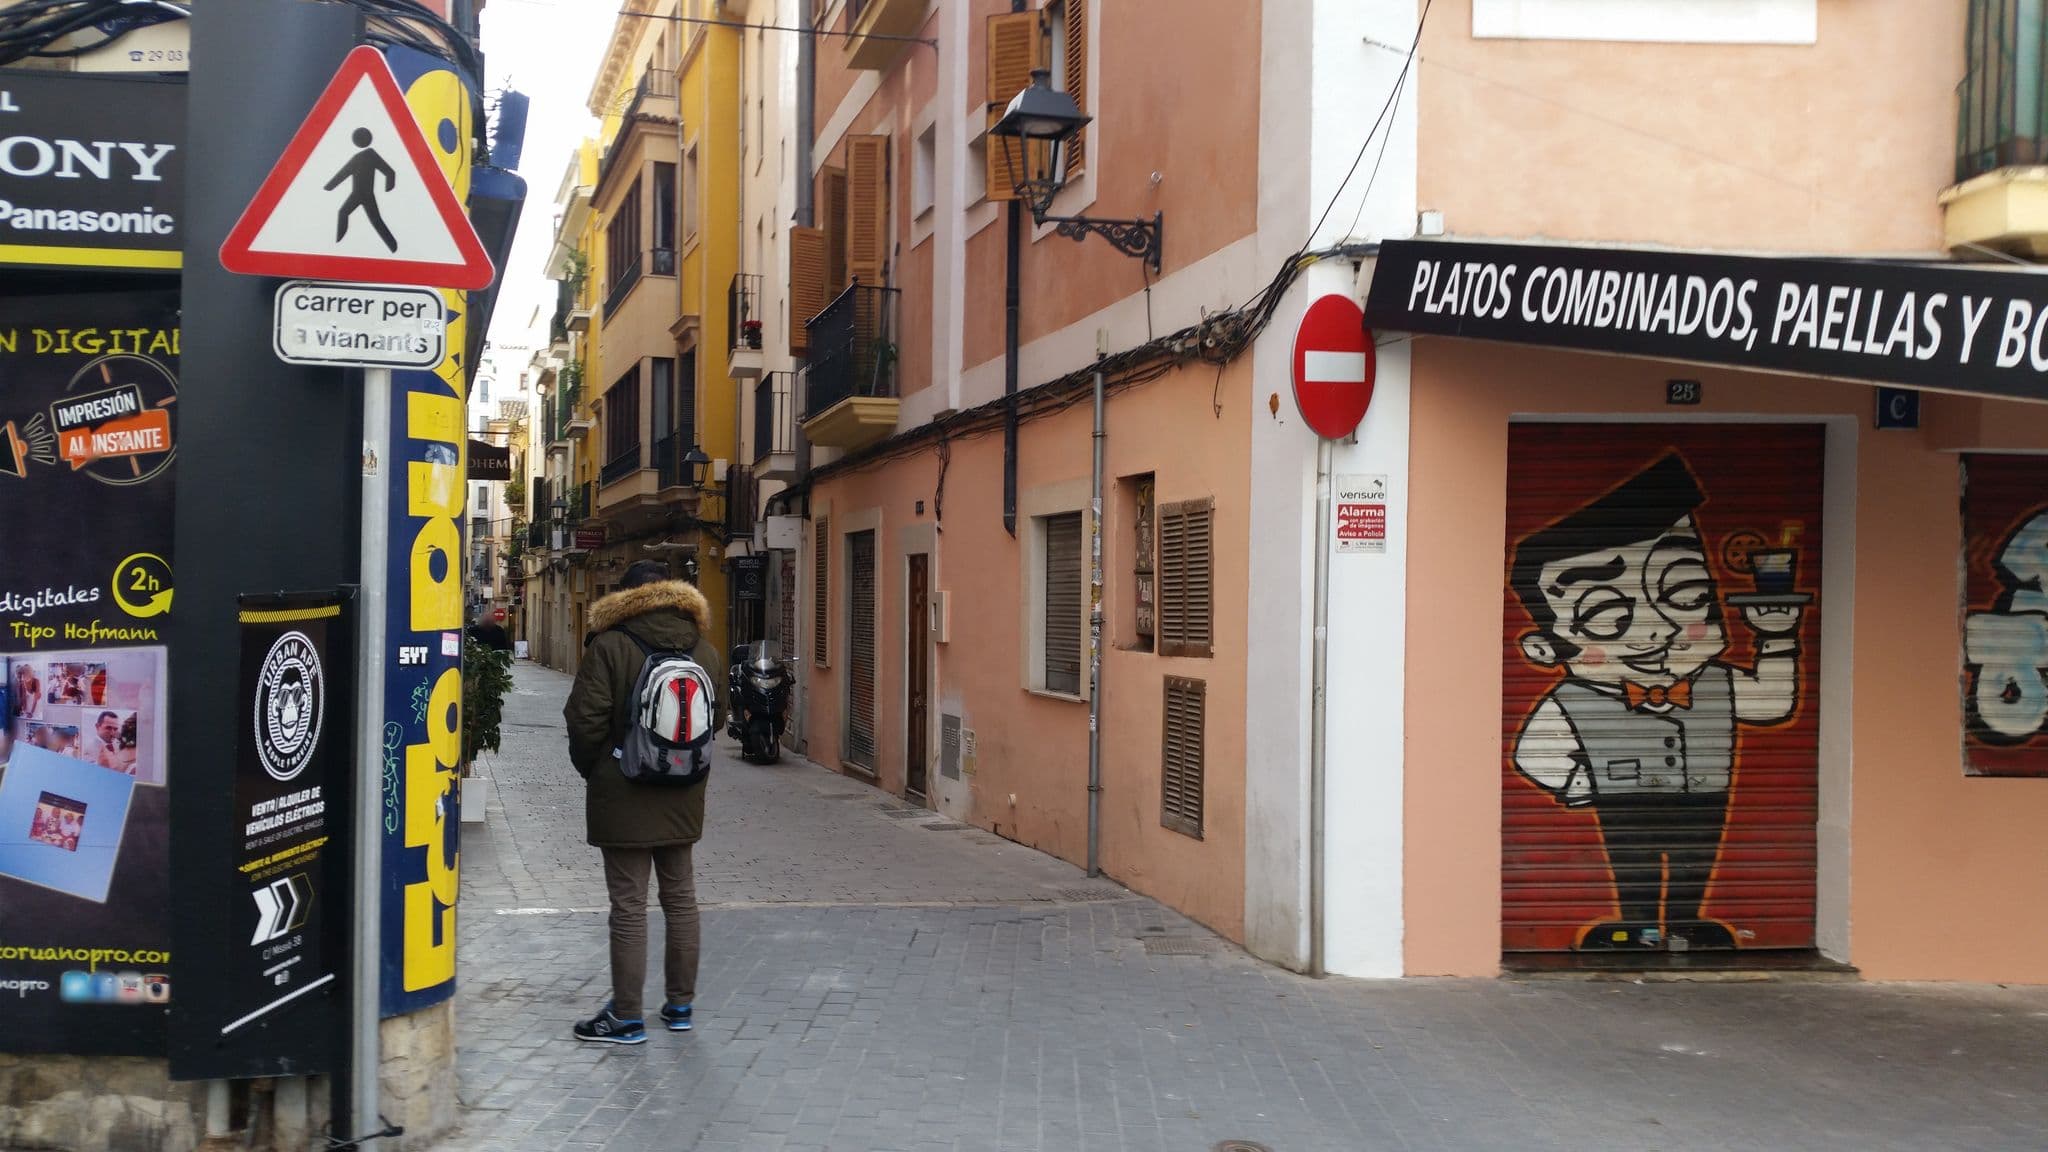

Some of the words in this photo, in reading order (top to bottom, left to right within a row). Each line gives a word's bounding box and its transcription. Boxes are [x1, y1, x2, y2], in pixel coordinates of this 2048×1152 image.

[148, 50, 163, 62] 29
[294, 294, 374, 315] carrer
[382, 300, 427, 321] per
[1407, 259, 1518, 320] PLATOS
[1521, 264, 1759, 351] COMBINADOS,
[1770, 281, 1948, 361] PAELLAS
[1959, 295, 1993, 364] Y
[1672, 382, 1695, 401] 25
[58, 391, 136, 427] IMPRESIÓN
[1888, 394, 1907, 420] C
[91, 427, 163, 455] INSTANTE
[1340, 490, 1385, 500] verisure
[1339, 506, 1384, 517] Alarma
[0, 585, 100, 617] digitales
[10, 621, 56, 648] Tipo
[65, 620, 158, 645] Hofmann
[263, 641, 298, 687] URBAN
[299, 646, 319, 681] APE
[265, 739, 285, 768] PEOPLE
